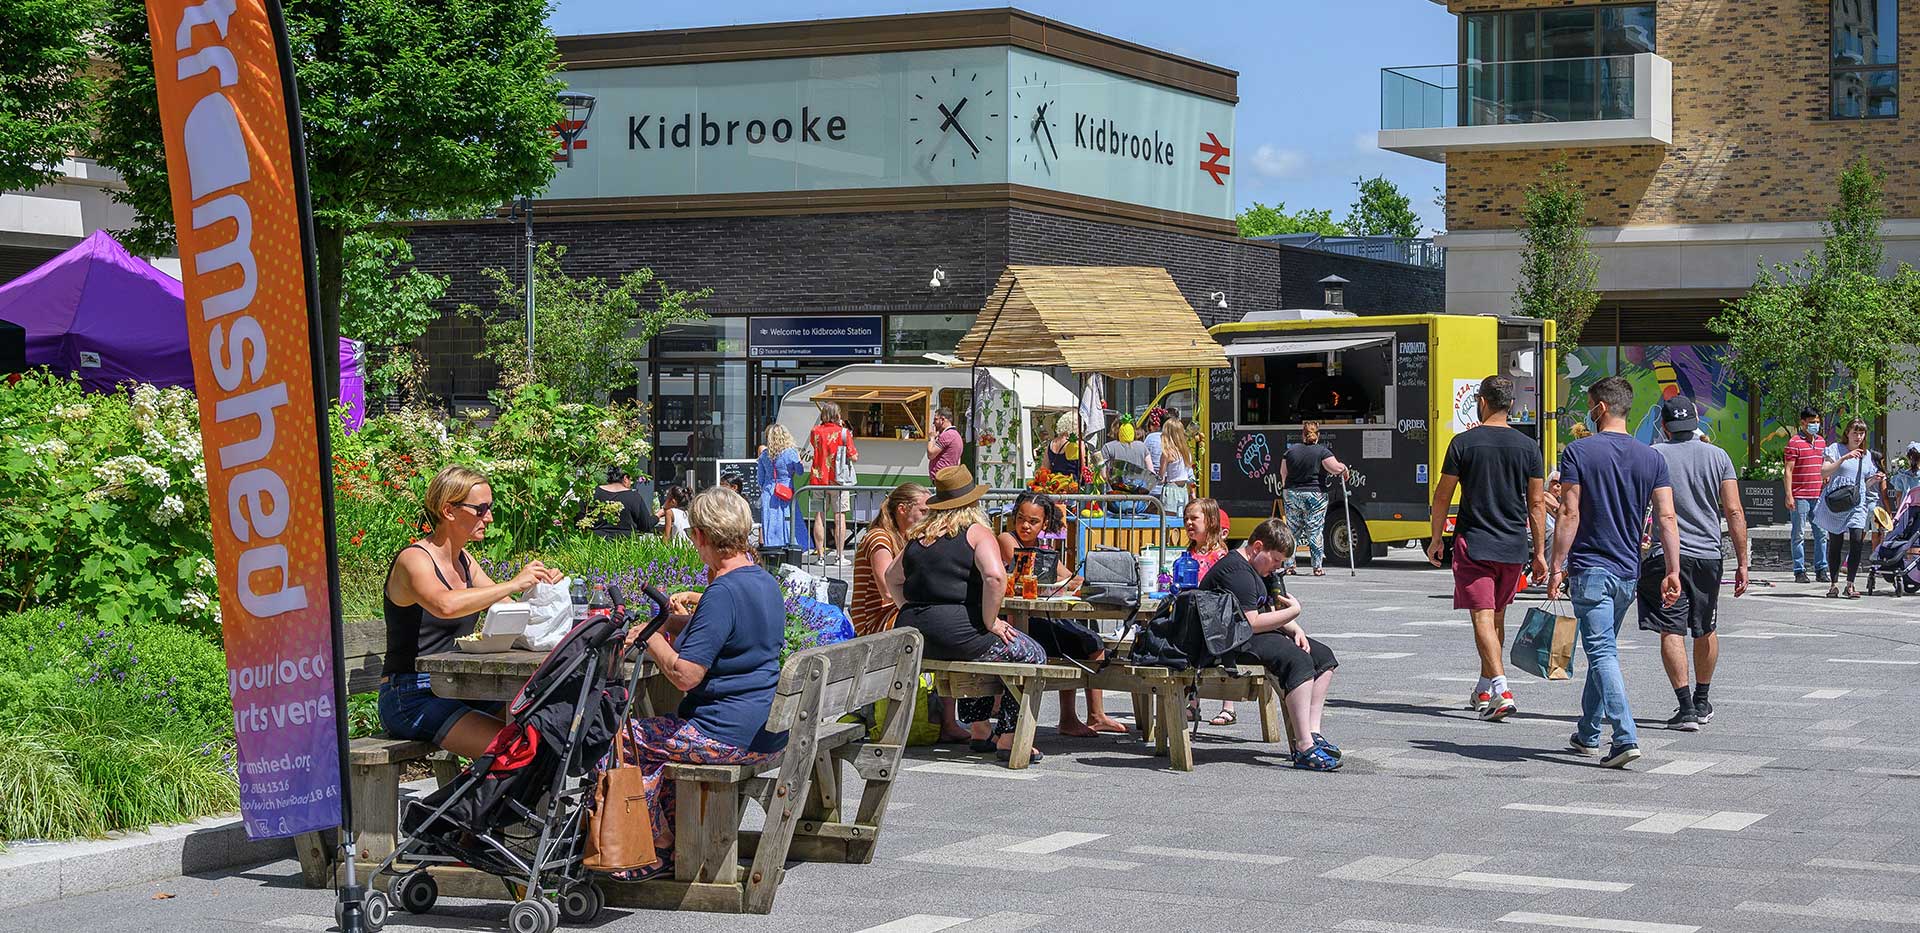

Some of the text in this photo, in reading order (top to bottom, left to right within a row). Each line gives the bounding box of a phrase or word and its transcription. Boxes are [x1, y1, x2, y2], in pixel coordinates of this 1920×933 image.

[627, 106, 847, 150] Kidbrooke
[1074, 112, 1175, 167] Kidbrooke
[770, 328, 801, 336] Welcome
[811, 327, 846, 335] Kidbrooke
[847, 327, 872, 335] Station
[1455, 384, 1471, 409] PIZZA
[1398, 419, 1428, 434] ORDER
[1236, 433, 1253, 459] PIZZA
[1247, 454, 1272, 479] SQUAD
[1752, 497, 1774, 507] VILLAGE
[229, 663, 274, 698] your
[242, 797, 276, 812] oolwich
